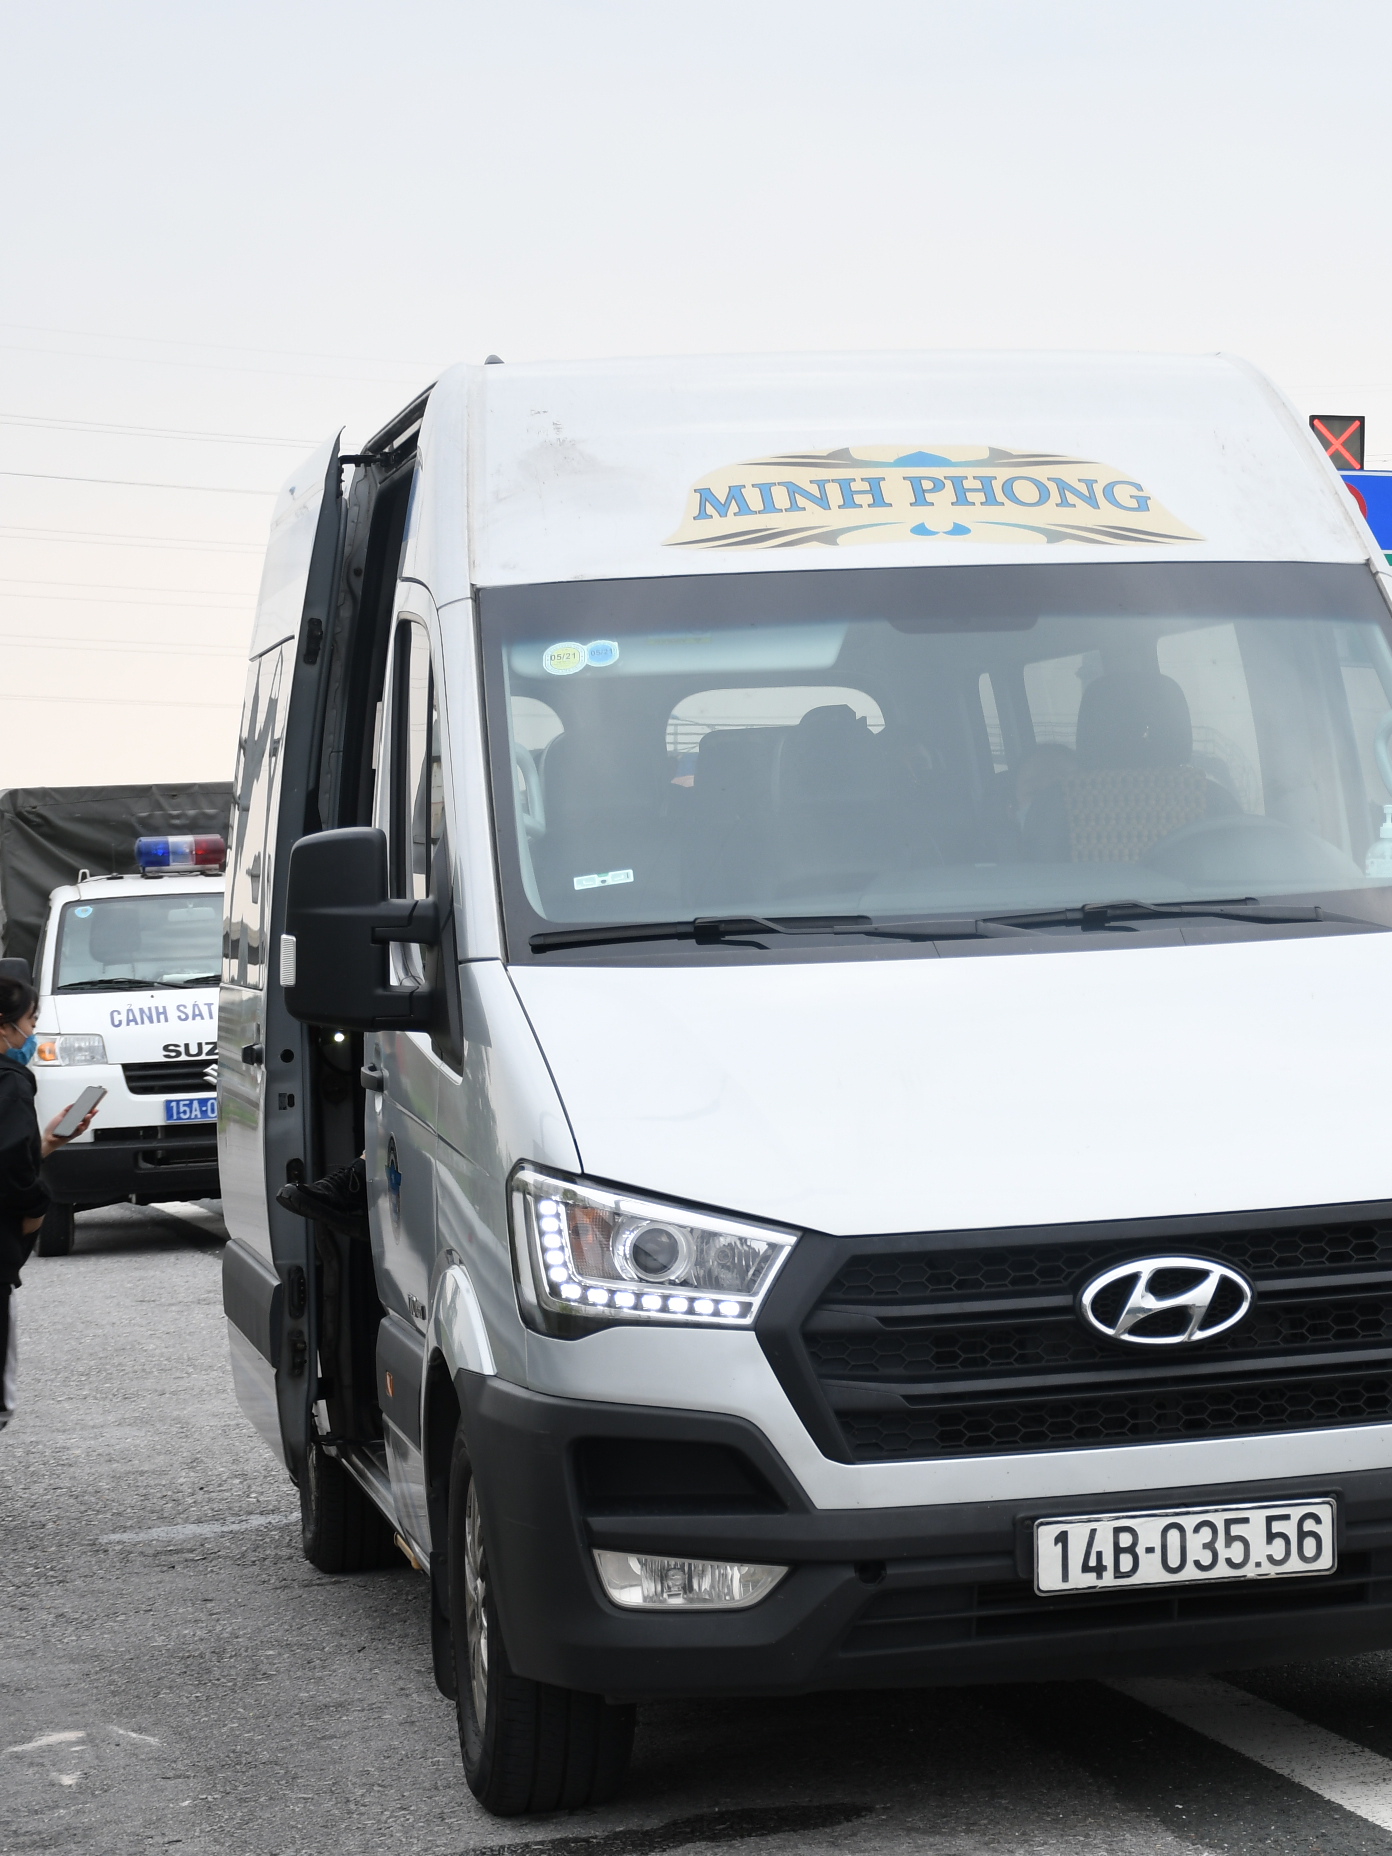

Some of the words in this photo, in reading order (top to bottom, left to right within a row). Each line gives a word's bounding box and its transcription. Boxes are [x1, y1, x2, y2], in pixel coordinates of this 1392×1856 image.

[693, 477, 893, 520] MINH
[903, 476, 1151, 512] PHONG
[550, 652, 577, 662] 05/21
[109, 1003, 169, 1028] CẢNH
[176, 1001, 214, 1022] SÁT
[1053, 1511, 1324, 1583] 14B-035.56
